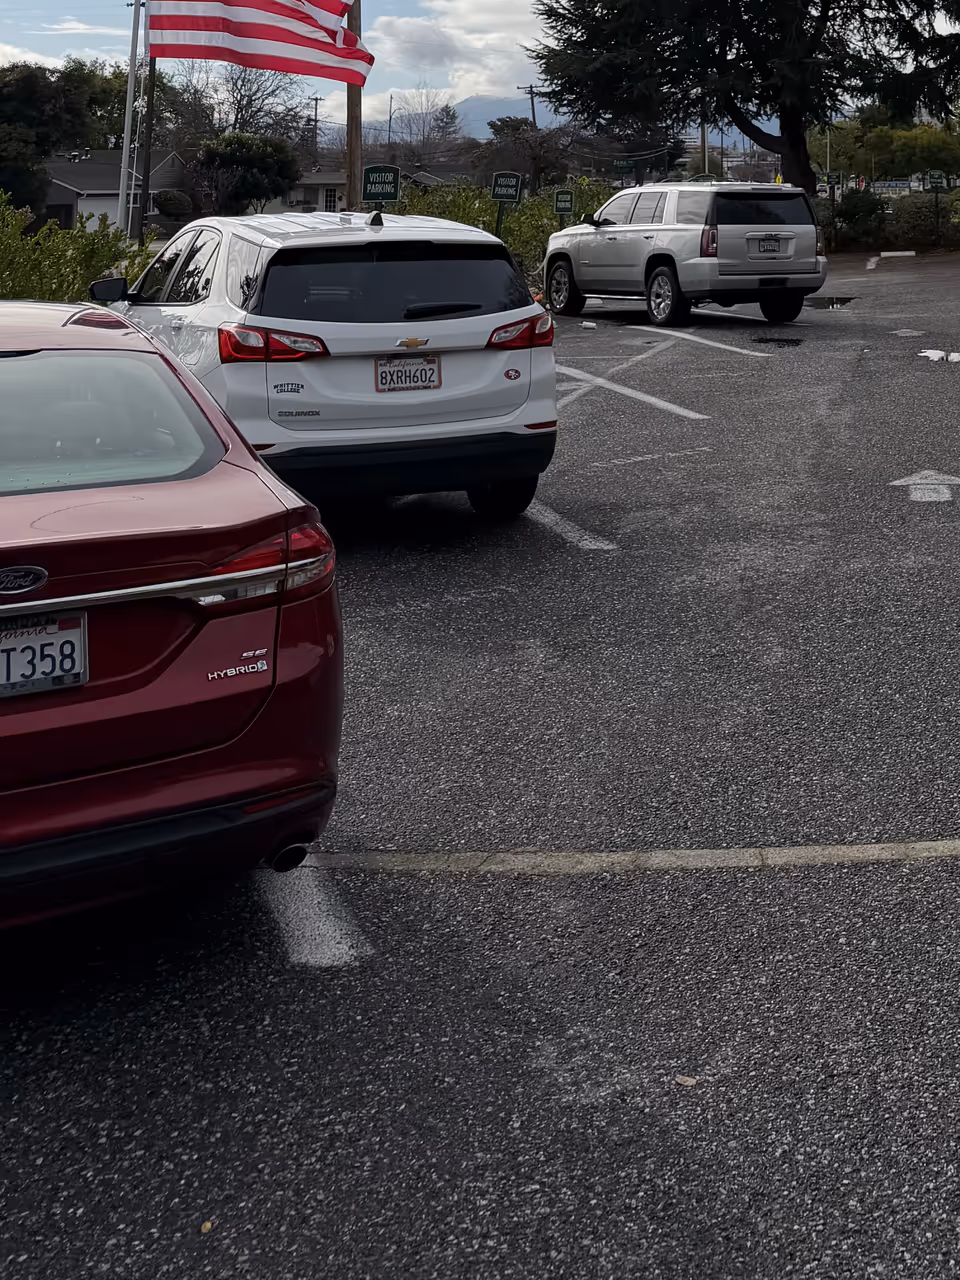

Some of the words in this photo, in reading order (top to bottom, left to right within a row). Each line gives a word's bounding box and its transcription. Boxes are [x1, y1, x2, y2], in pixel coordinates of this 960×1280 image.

[369, 172, 394, 182] VISITOR
[497, 177, 517, 186] VISITOR
[366, 182, 395, 194] PARKING
[494, 185, 516, 195] PARKING
[389, 360, 427, 370] California
[380, 368, 435, 386] 8XRH602
[273, 382, 305, 390] WHITTIER
[0, 572, 34, 588] Ford
[240, 648, 268, 660] SE
[208, 663, 258, 681] HYBRID
